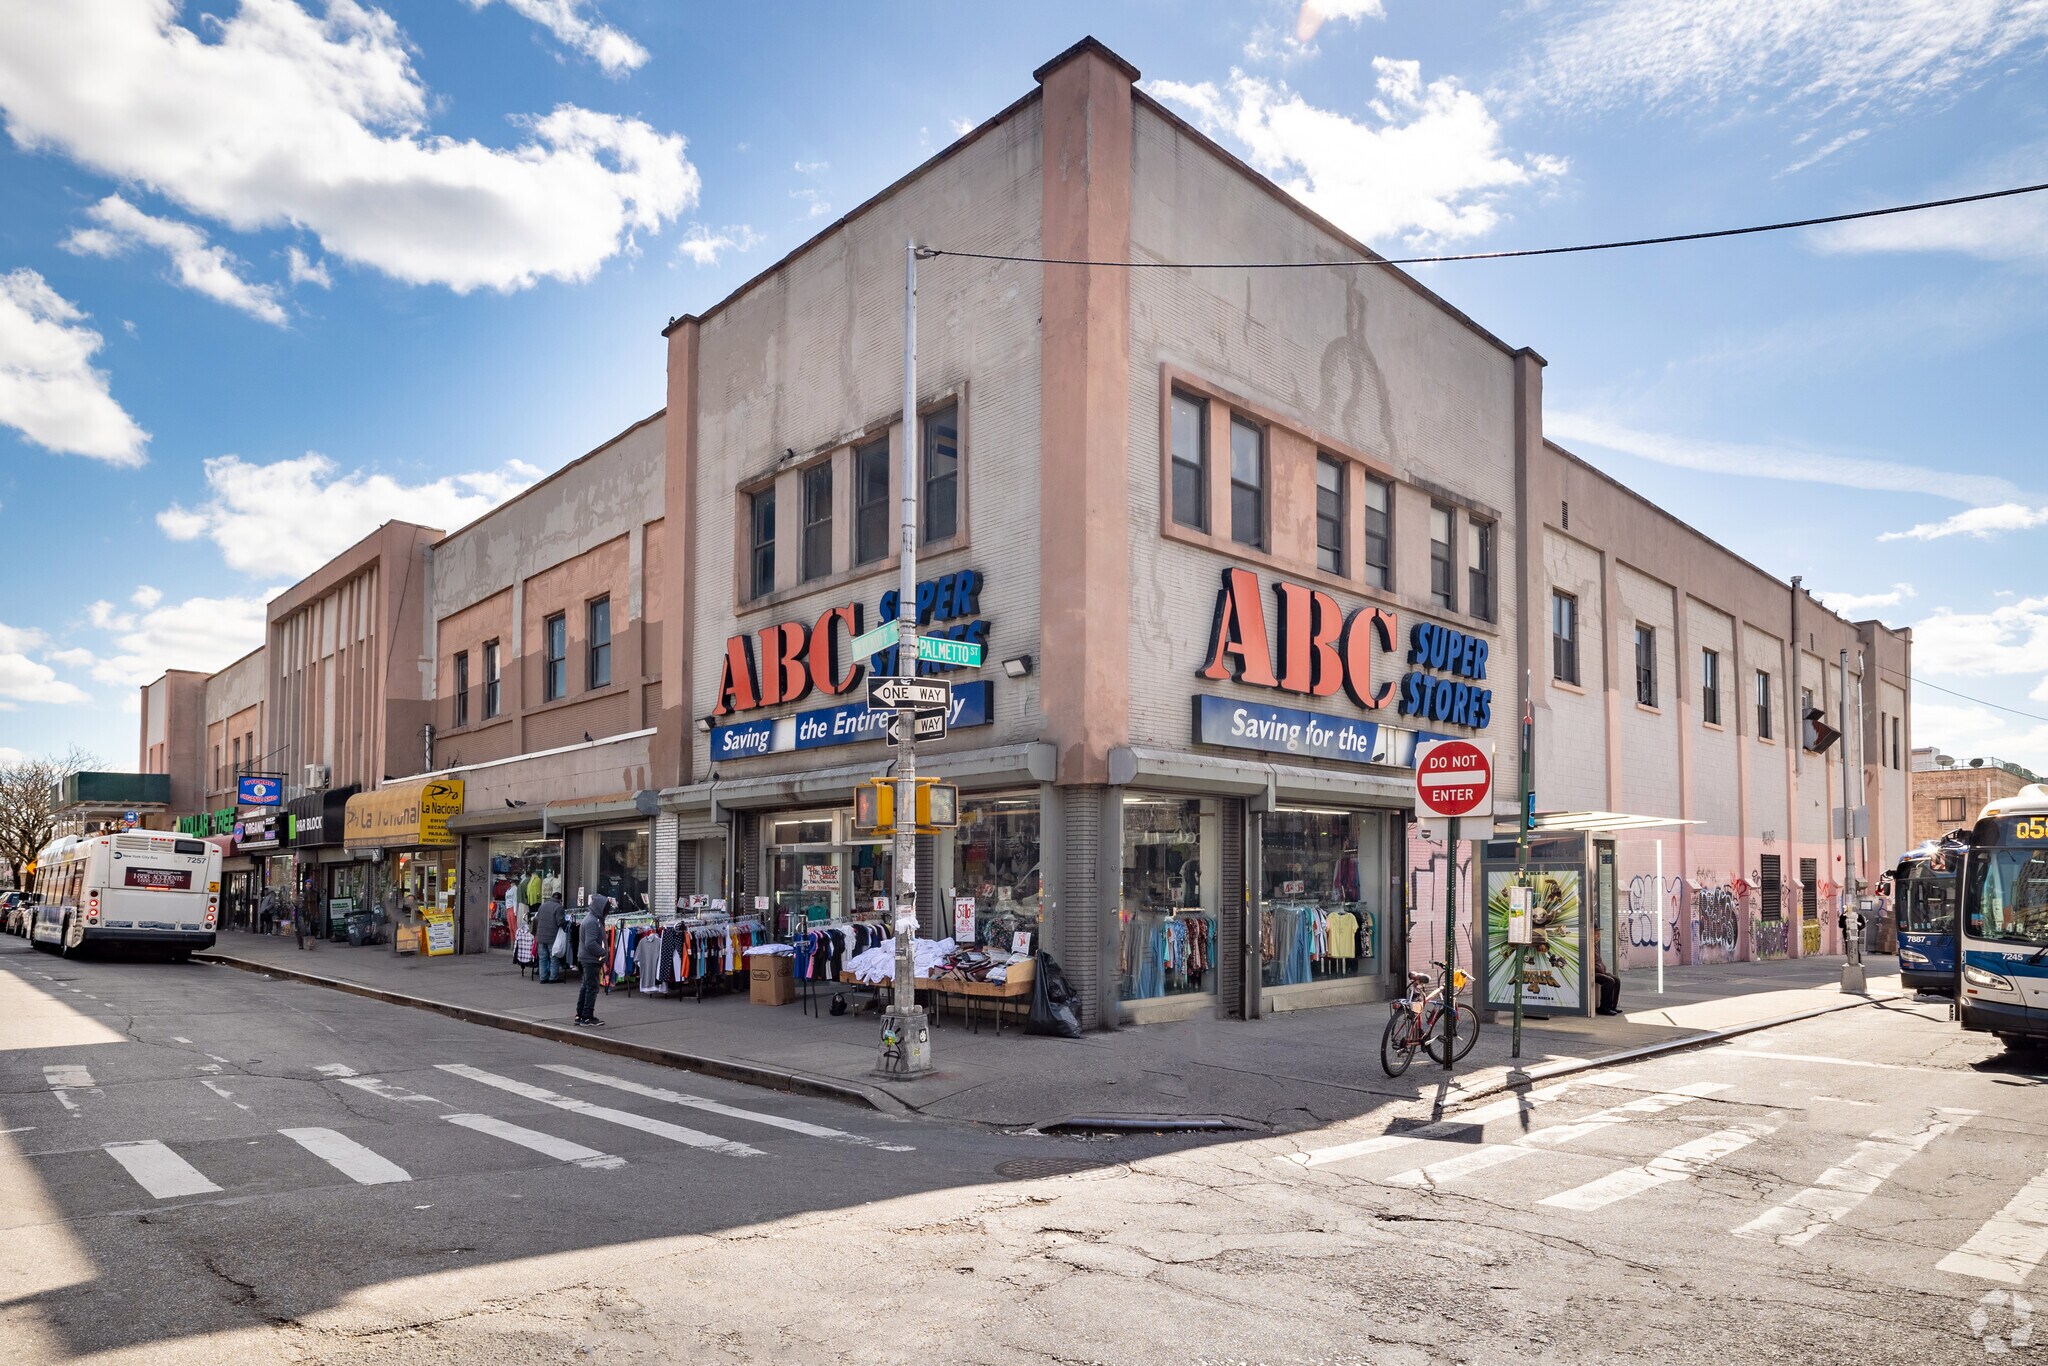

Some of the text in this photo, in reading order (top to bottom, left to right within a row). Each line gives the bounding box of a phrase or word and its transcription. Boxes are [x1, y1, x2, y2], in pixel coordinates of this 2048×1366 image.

[1195, 567, 1397, 709] ABC
[712, 601, 864, 716] ABC
[920, 640, 979, 662] PALMETTO ST
[1408, 621, 1488, 680] SUPER
[882, 687, 941, 699] ONE WAY
[1398, 671, 1492, 729] STORES
[723, 728, 770, 752] Saving
[800, 717, 827, 740] the
[833, 708, 889, 736] Entire
[921, 717, 940, 732] WAY
[1231, 708, 1367, 753] Saving for the
[1430, 755, 1478, 769] DO NOT
[1432, 788, 1473, 802] ENTER
[421, 802, 462, 815] La Nacional
[182, 807, 237, 838] DOLLAR TREE
[245, 820, 266, 836] ORGANIC
[296, 815, 323, 833] H&R BLOCK
[2016, 817, 2048, 839] Q5
[187, 856, 207, 864] 7257
[2002, 952, 2024, 961] 7245
